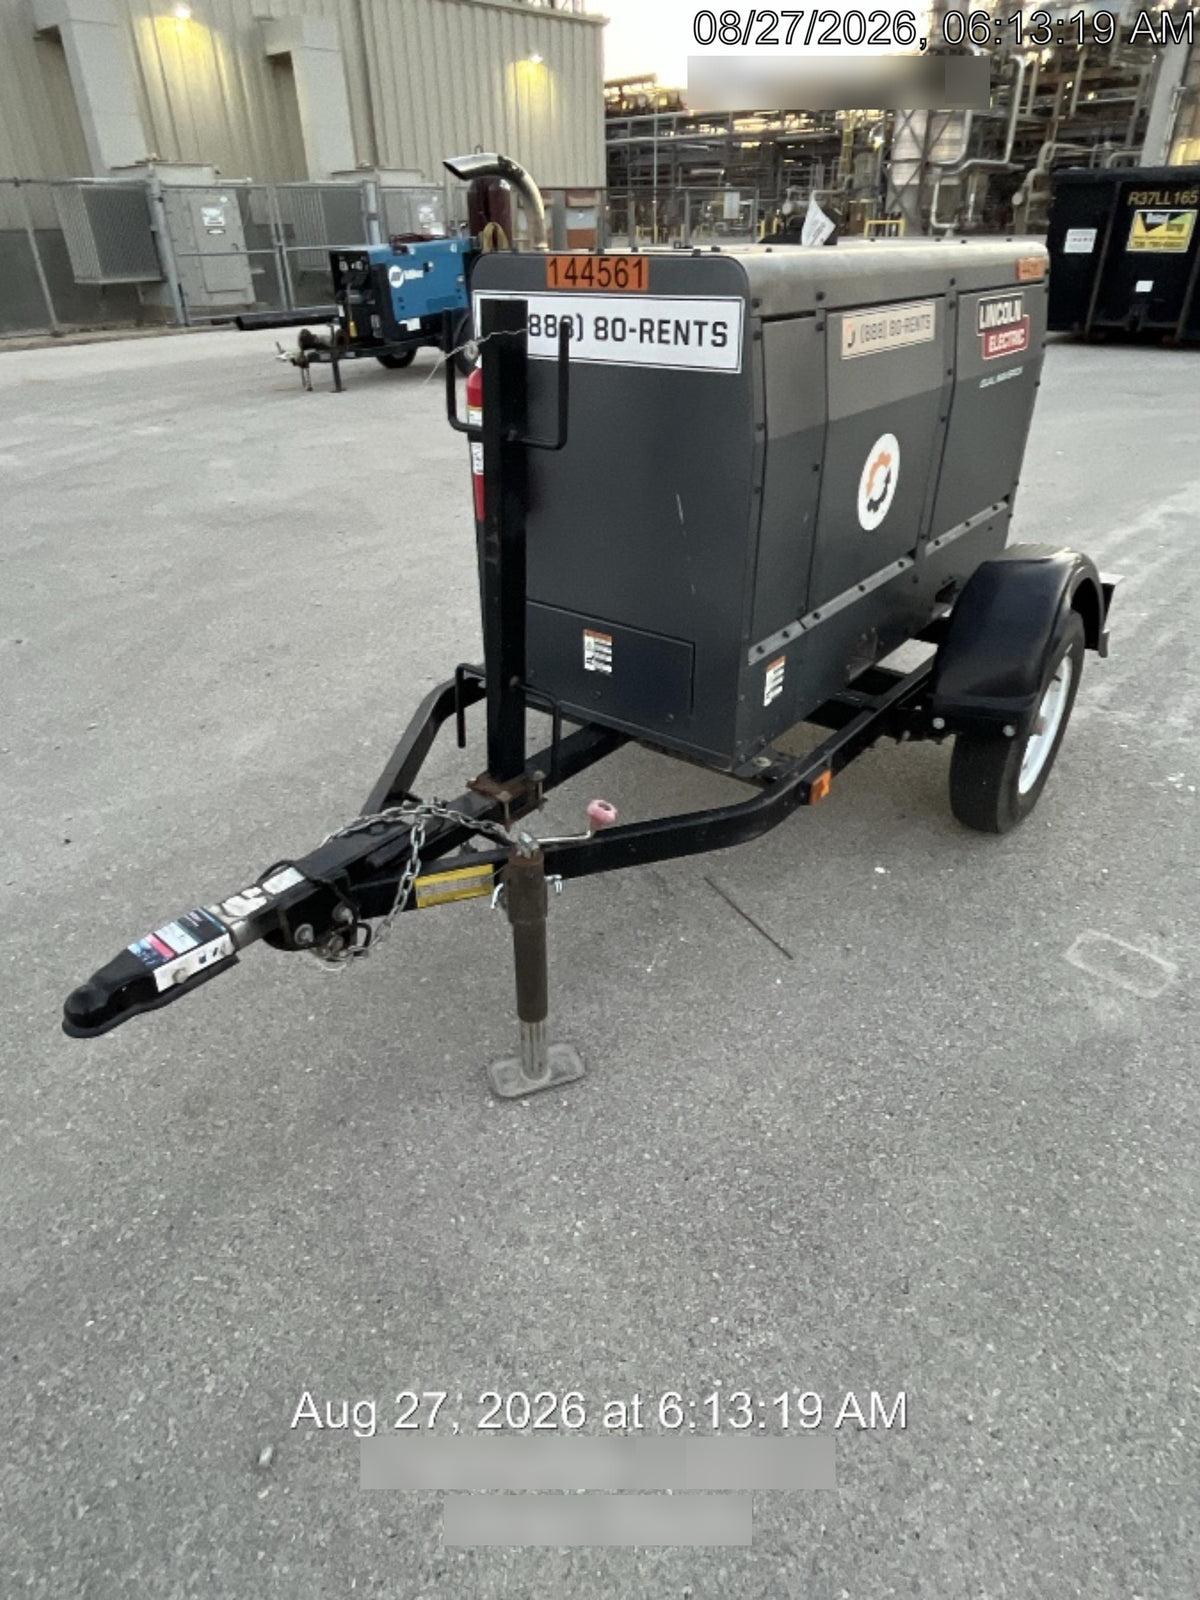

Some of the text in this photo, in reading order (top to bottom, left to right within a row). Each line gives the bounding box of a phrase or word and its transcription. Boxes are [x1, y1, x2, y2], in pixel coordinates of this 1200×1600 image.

[548, 256, 645, 288] 144561
[528, 312, 729, 348] 888) 80-RENTS
[979, 299, 1022, 330] LINCOLN
[987, 327, 1026, 353] ELECTRIC
